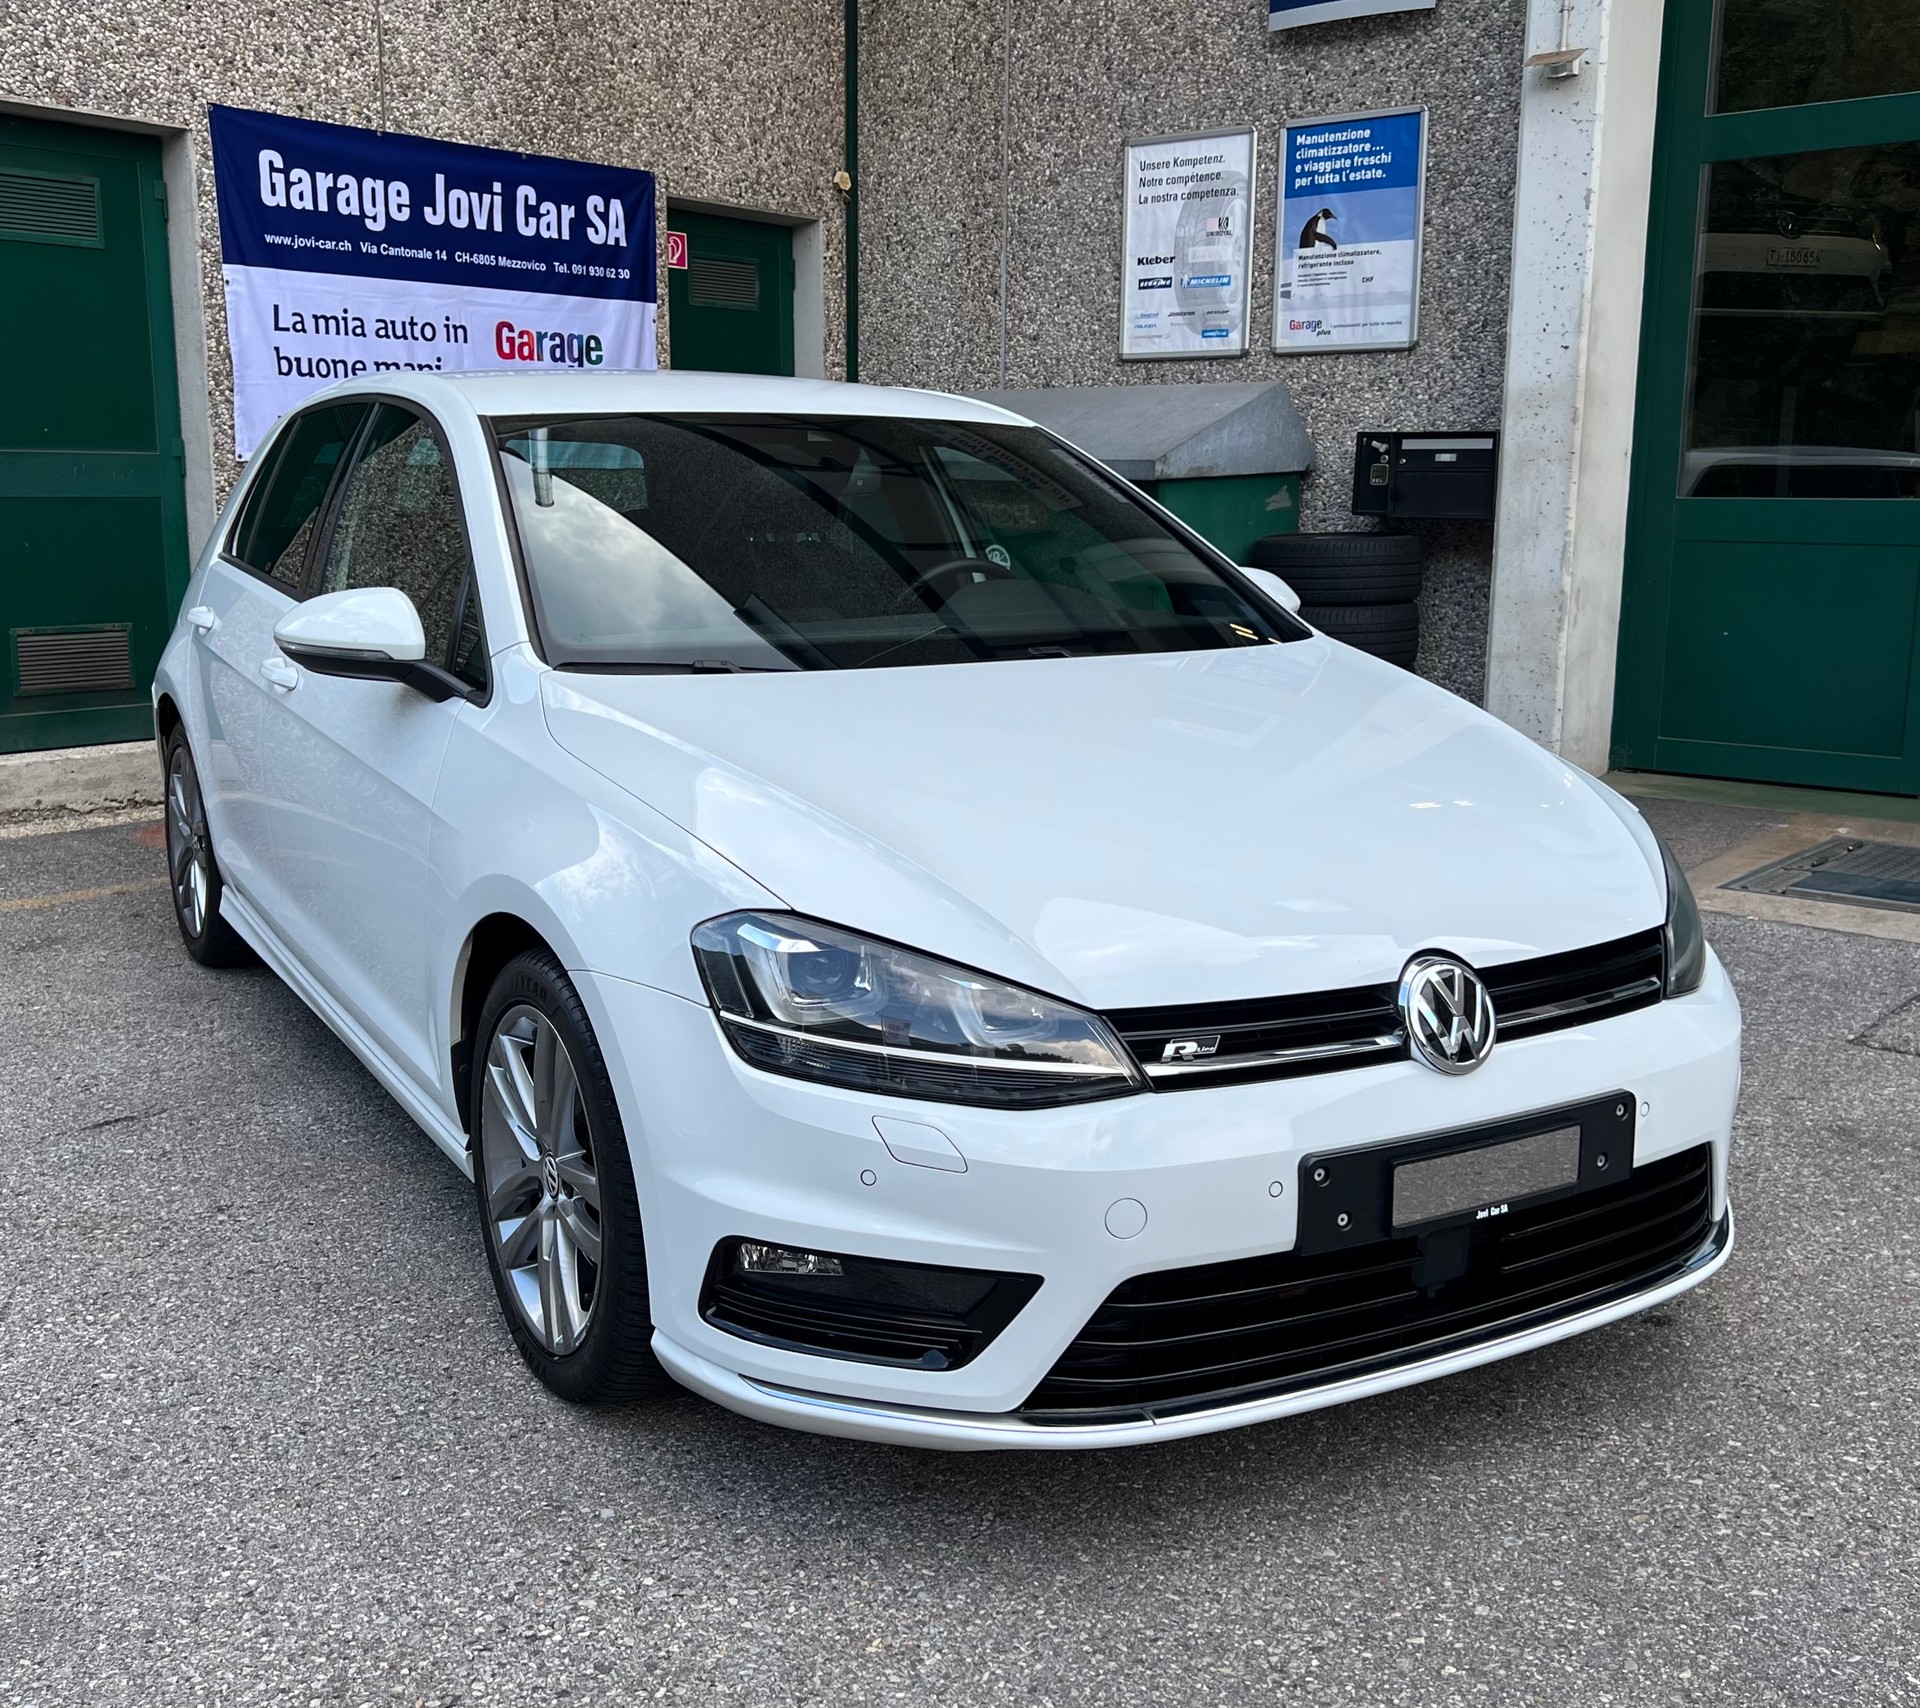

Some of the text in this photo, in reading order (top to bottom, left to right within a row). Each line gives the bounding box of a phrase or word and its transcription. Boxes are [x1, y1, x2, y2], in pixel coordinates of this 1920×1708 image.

[1296, 129, 1370, 146] Manutenzione
[1295, 143, 1384, 159] climatizzatore...
[1140, 155, 1226, 172] Unsere Kompetenz.
[1295, 152, 1392, 173] e viaggiate freschi
[1139, 171, 1224, 188] Notre compétence.
[1294, 168, 1387, 190] per tutta l'estate.
[258, 149, 628, 247] Garage Jovi Car SA
[1138, 187, 1240, 205] La nostra competenza.
[264, 233, 630, 280] www.jovi-car.ch Via Cantonale 14 CH-6805 Mezzovico Tel. 091 930 62 30
[1137, 255, 1176, 266] Kleber
[1298, 252, 1337, 262] Manutenzione
[1298, 261, 1332, 270] refrigerante
[1190, 276, 1230, 286] MICHELIN
[273, 304, 469, 344] La mia auto in
[1289, 319, 1322, 333] Garage
[1316, 329, 1331, 337] plus
[494, 320, 604, 368] Garage
[273, 346, 368, 379] buone
[1161, 1041, 1198, 1062] R
[1500, 1204, 1508, 1213] SA
